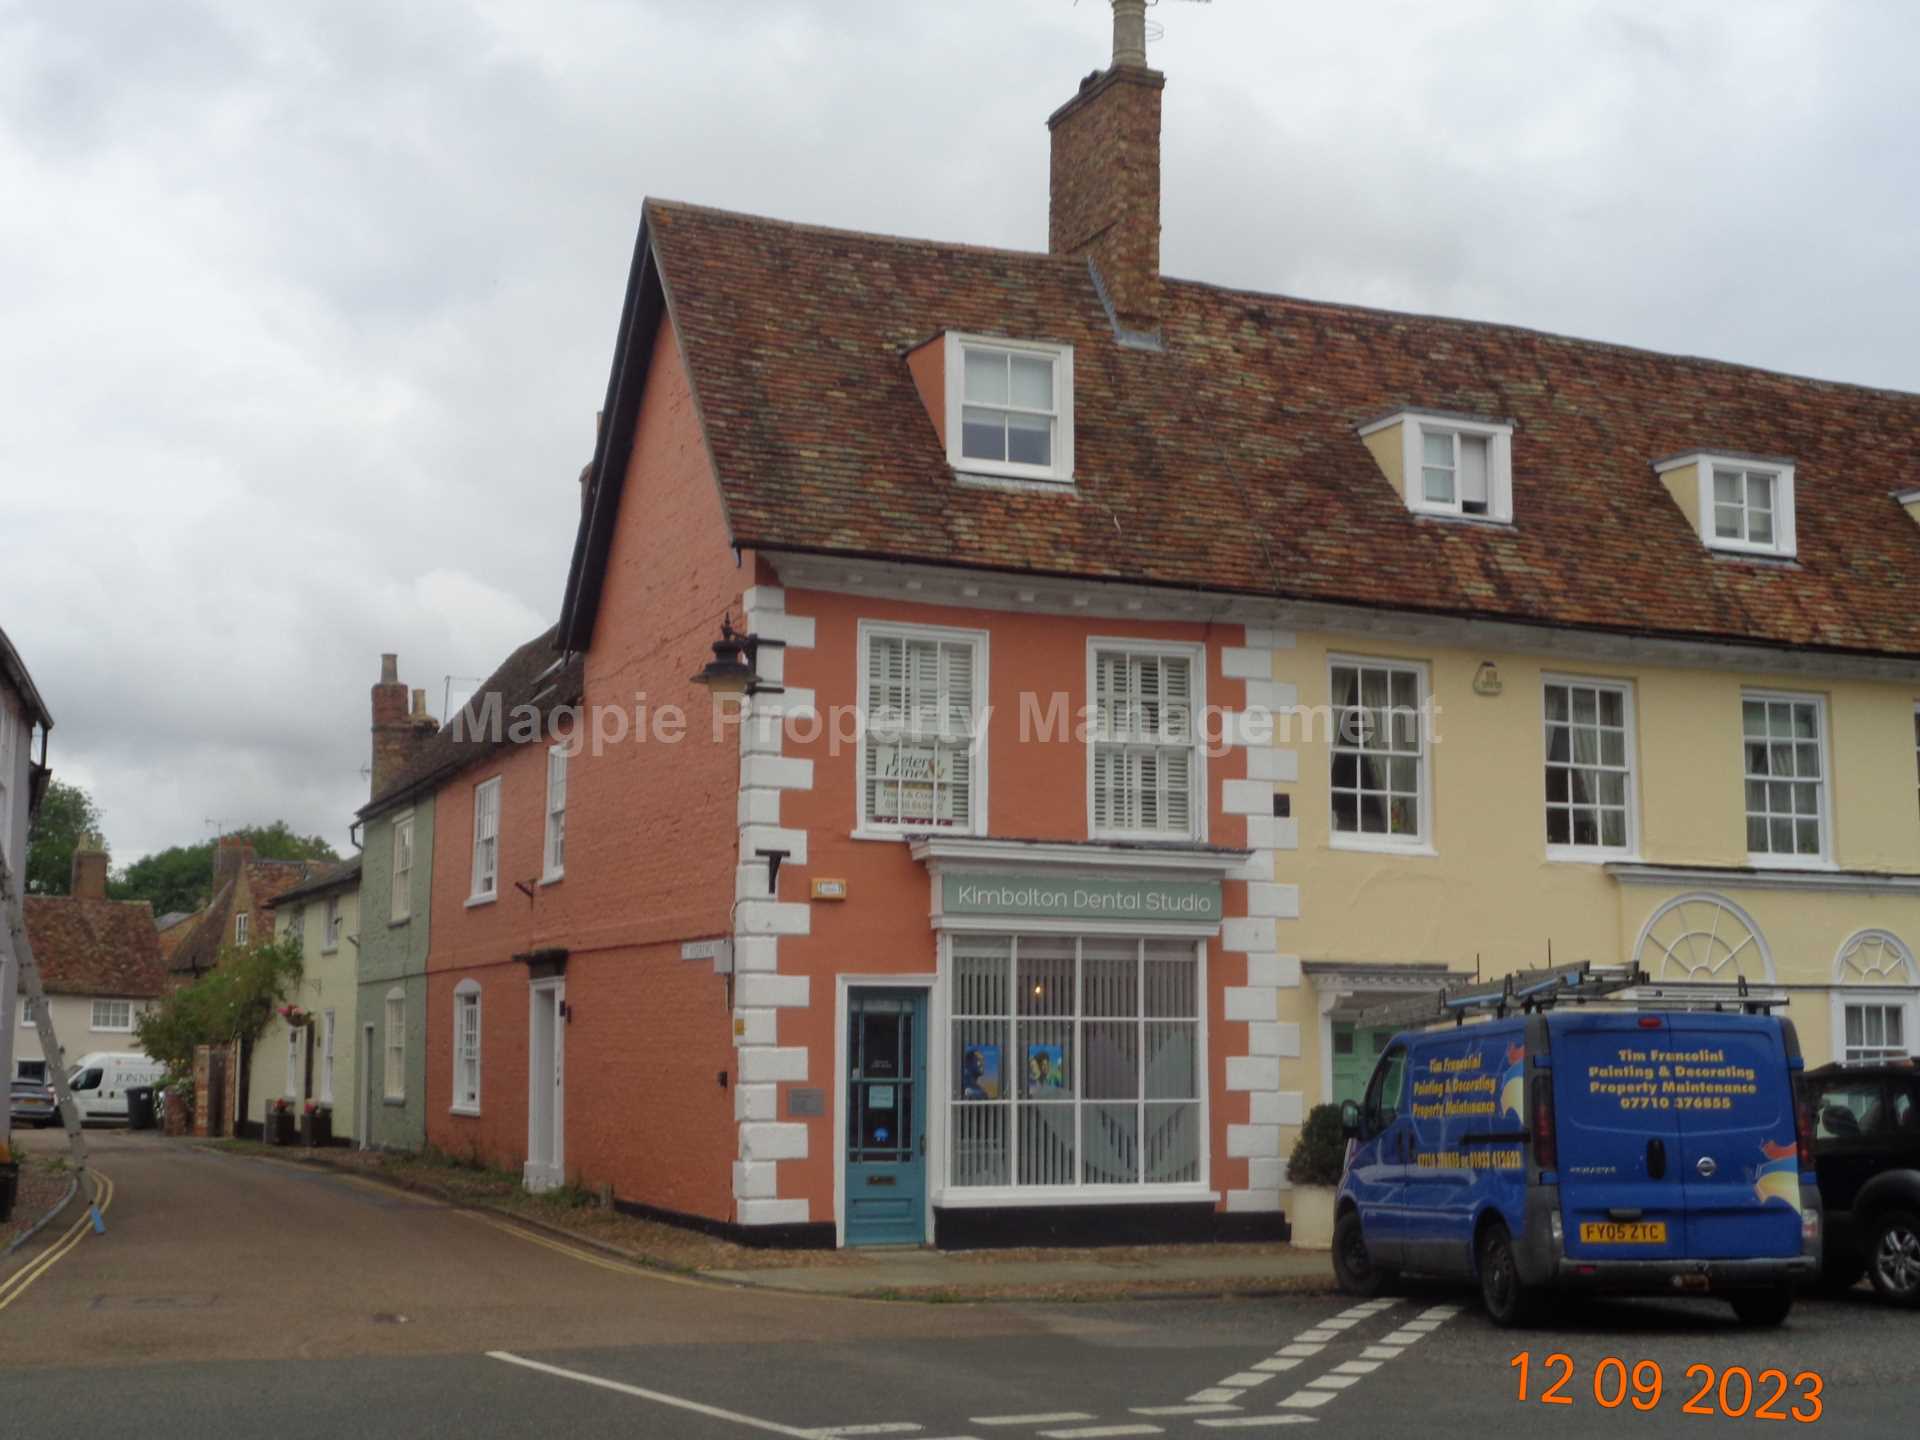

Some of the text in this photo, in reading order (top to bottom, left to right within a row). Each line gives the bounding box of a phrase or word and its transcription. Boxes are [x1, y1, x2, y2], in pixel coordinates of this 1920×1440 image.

[958, 886, 1211, 912] Kimbolton Dental Studio
[1619, 1049, 1724, 1062] Tim Francolini
[1589, 1065, 1755, 1080] Painting & Decorating
[1589, 1080, 1757, 1095] Property Maintenance
[1620, 1096, 1669, 1109] 07710
[1585, 1224, 1658, 1240] FY05 ZTC
